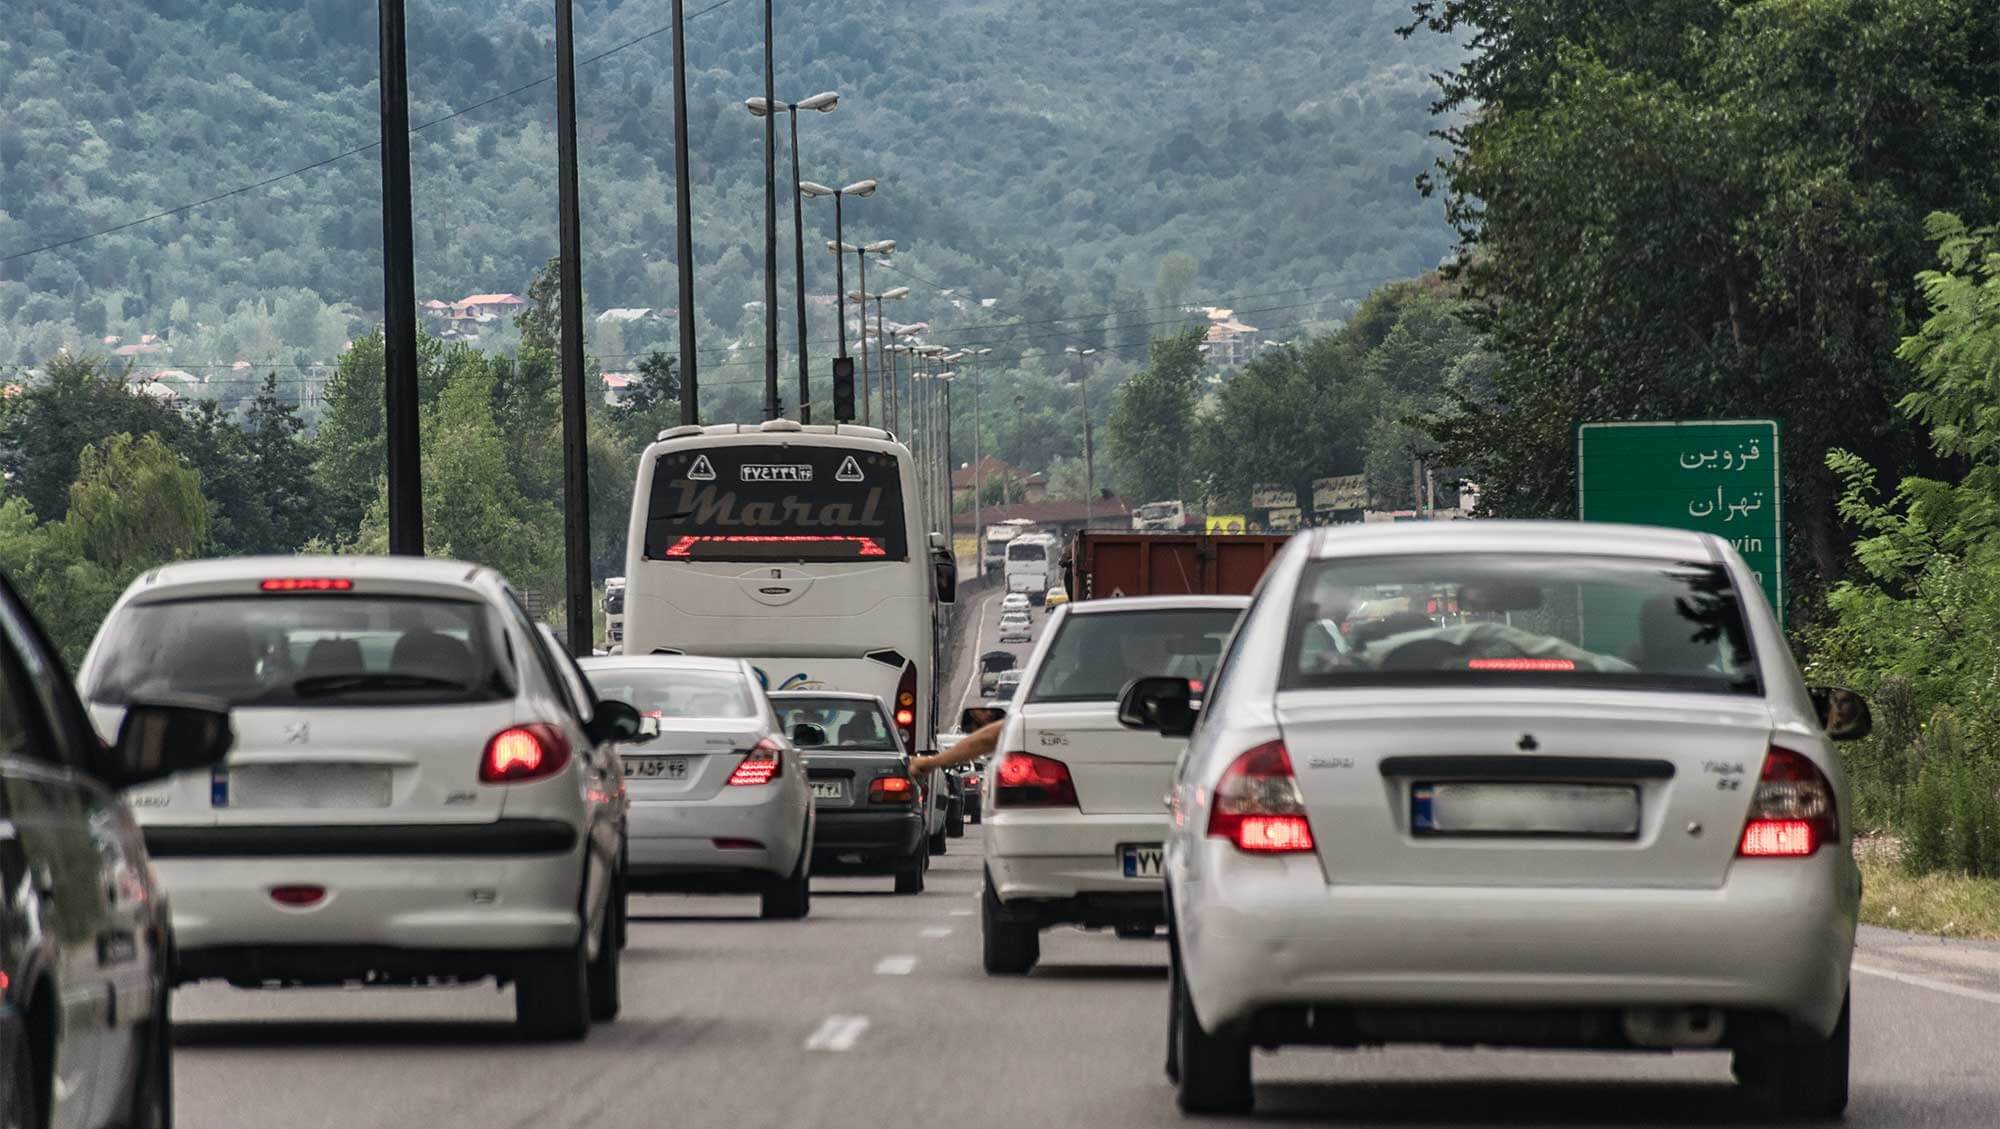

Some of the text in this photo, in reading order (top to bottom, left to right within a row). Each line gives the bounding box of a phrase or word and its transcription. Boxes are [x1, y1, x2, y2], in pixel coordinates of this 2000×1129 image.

[1680, 439, 1760, 470] قزوین
[669, 478, 885, 526] Maral
[1689, 485, 1763, 521] تهران
[1731, 534, 1762, 552] vin
